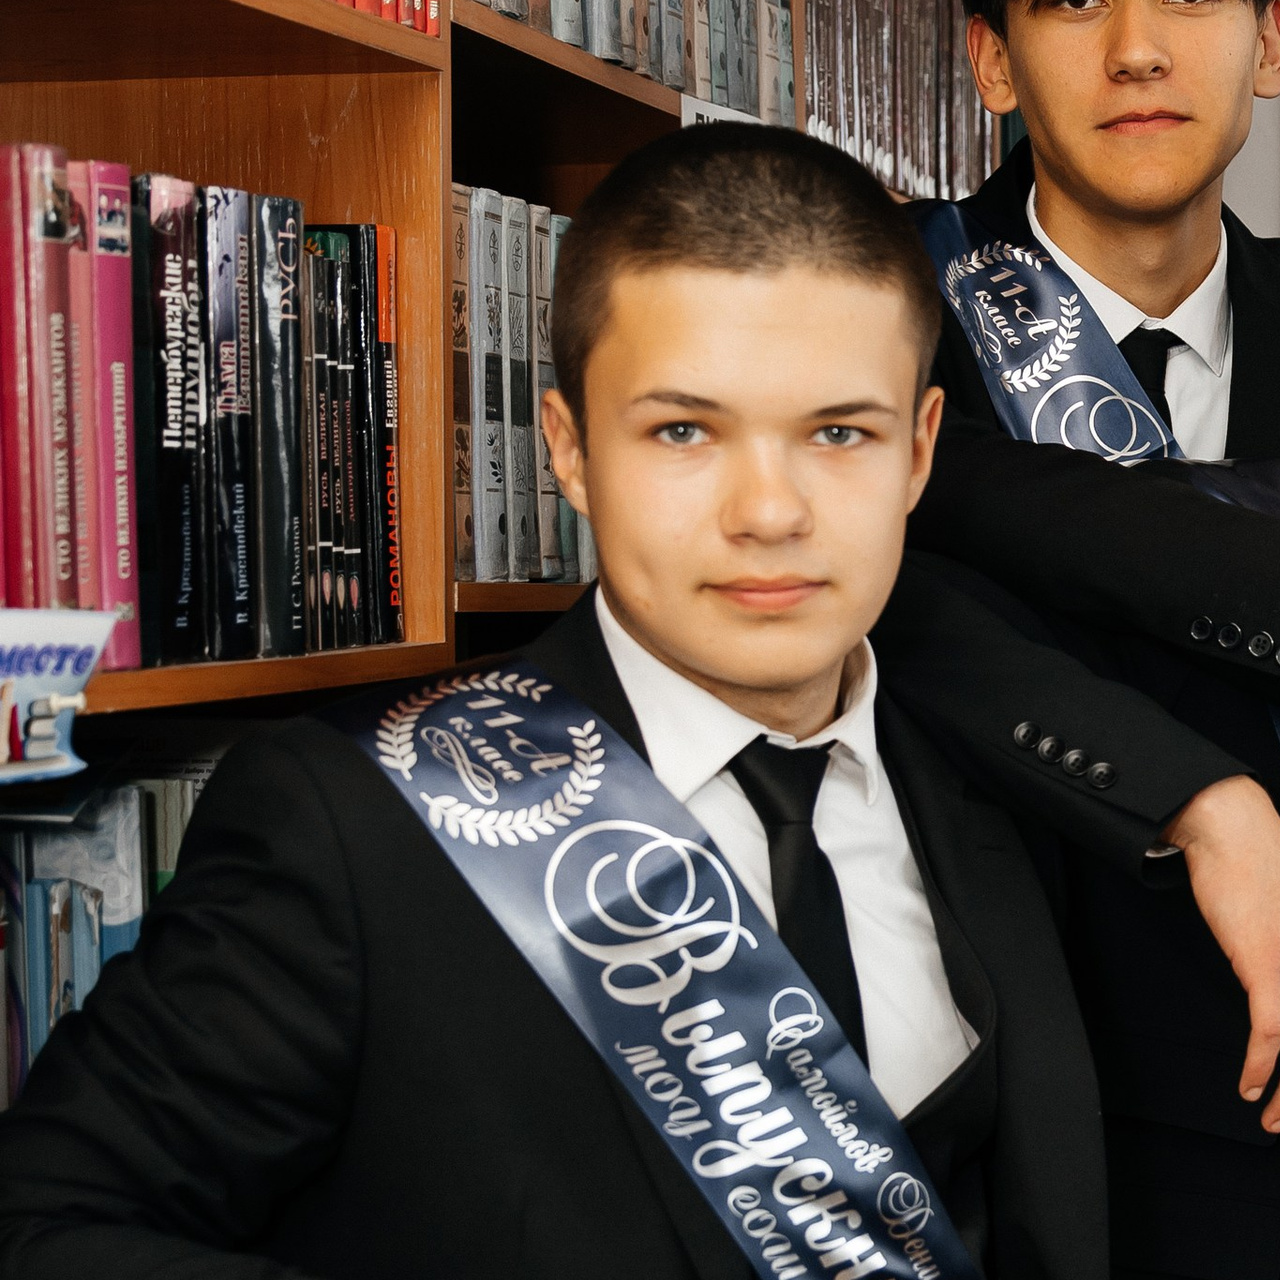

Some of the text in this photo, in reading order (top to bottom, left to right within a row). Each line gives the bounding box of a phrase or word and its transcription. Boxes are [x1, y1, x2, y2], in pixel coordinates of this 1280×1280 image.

[276, 217, 299, 321] РУСЬ
[975, 289, 1022, 349] класс
[990, 267, 1058, 342] 11-А
[159, 252, 184, 449] Петербургские
[215, 339, 237, 418] Тьма
[234, 233, 251, 416] Египетская
[50, 311, 72, 581] СТО ВЕЛИКИХ МУЗЫКАНТОВ
[318, 391, 328, 460] ВЕЛИКАЯ
[383, 358, 398, 428] Евгений
[110, 361, 132, 580] СТО ВЕЛИКИХ ИЗОБРЕТЕНИЙ
[332, 399, 342, 514] РУСЬ ВЕЛИКАЯ
[177, 483, 193, 605] Крестовский
[231, 482, 250, 601] Крестовский
[290, 516, 303, 586] Романов
[385, 444, 402, 607] РОМАНОВЫ
[448, 716, 525, 783] класс
[466, 693, 572, 778] 11-А
[766, 985, 894, 1175] Самойлов
